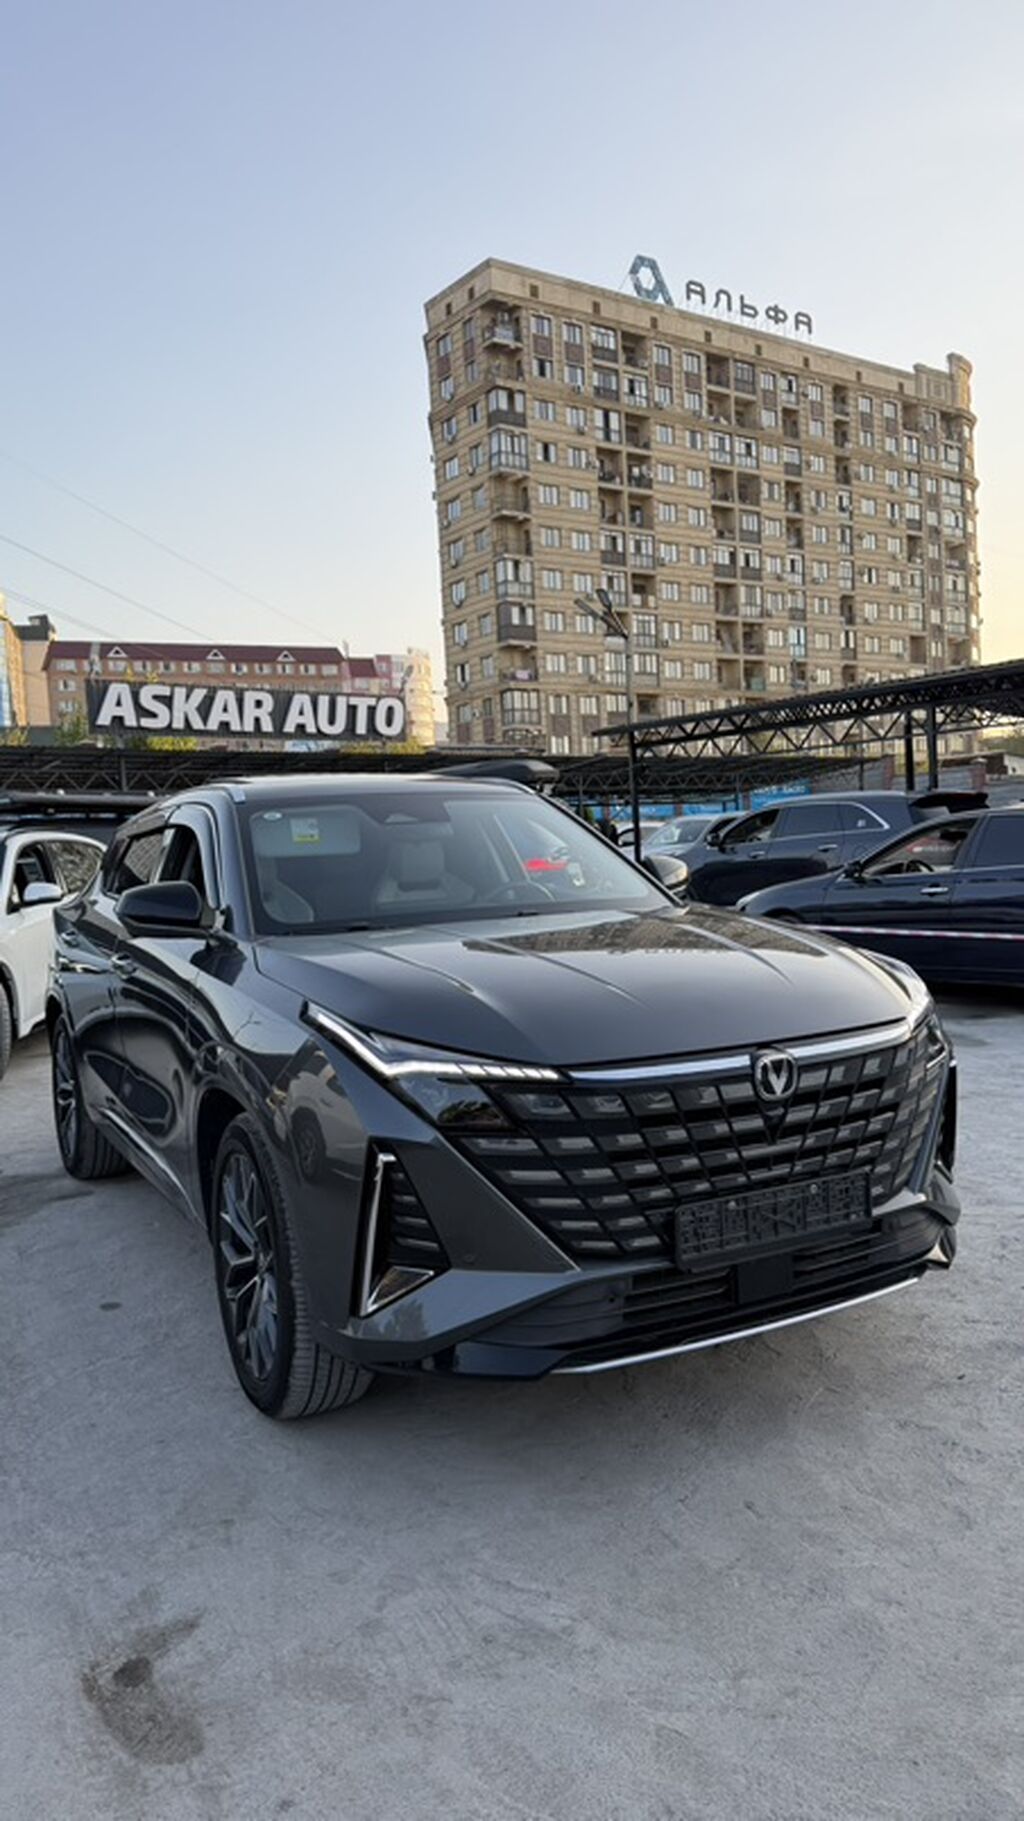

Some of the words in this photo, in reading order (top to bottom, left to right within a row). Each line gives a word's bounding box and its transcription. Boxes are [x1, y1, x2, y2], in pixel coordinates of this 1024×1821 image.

[685, 280, 812, 334] АЛЬФА
[95, 683, 273, 732] ASKAR
[283, 693, 404, 736] AUTO
